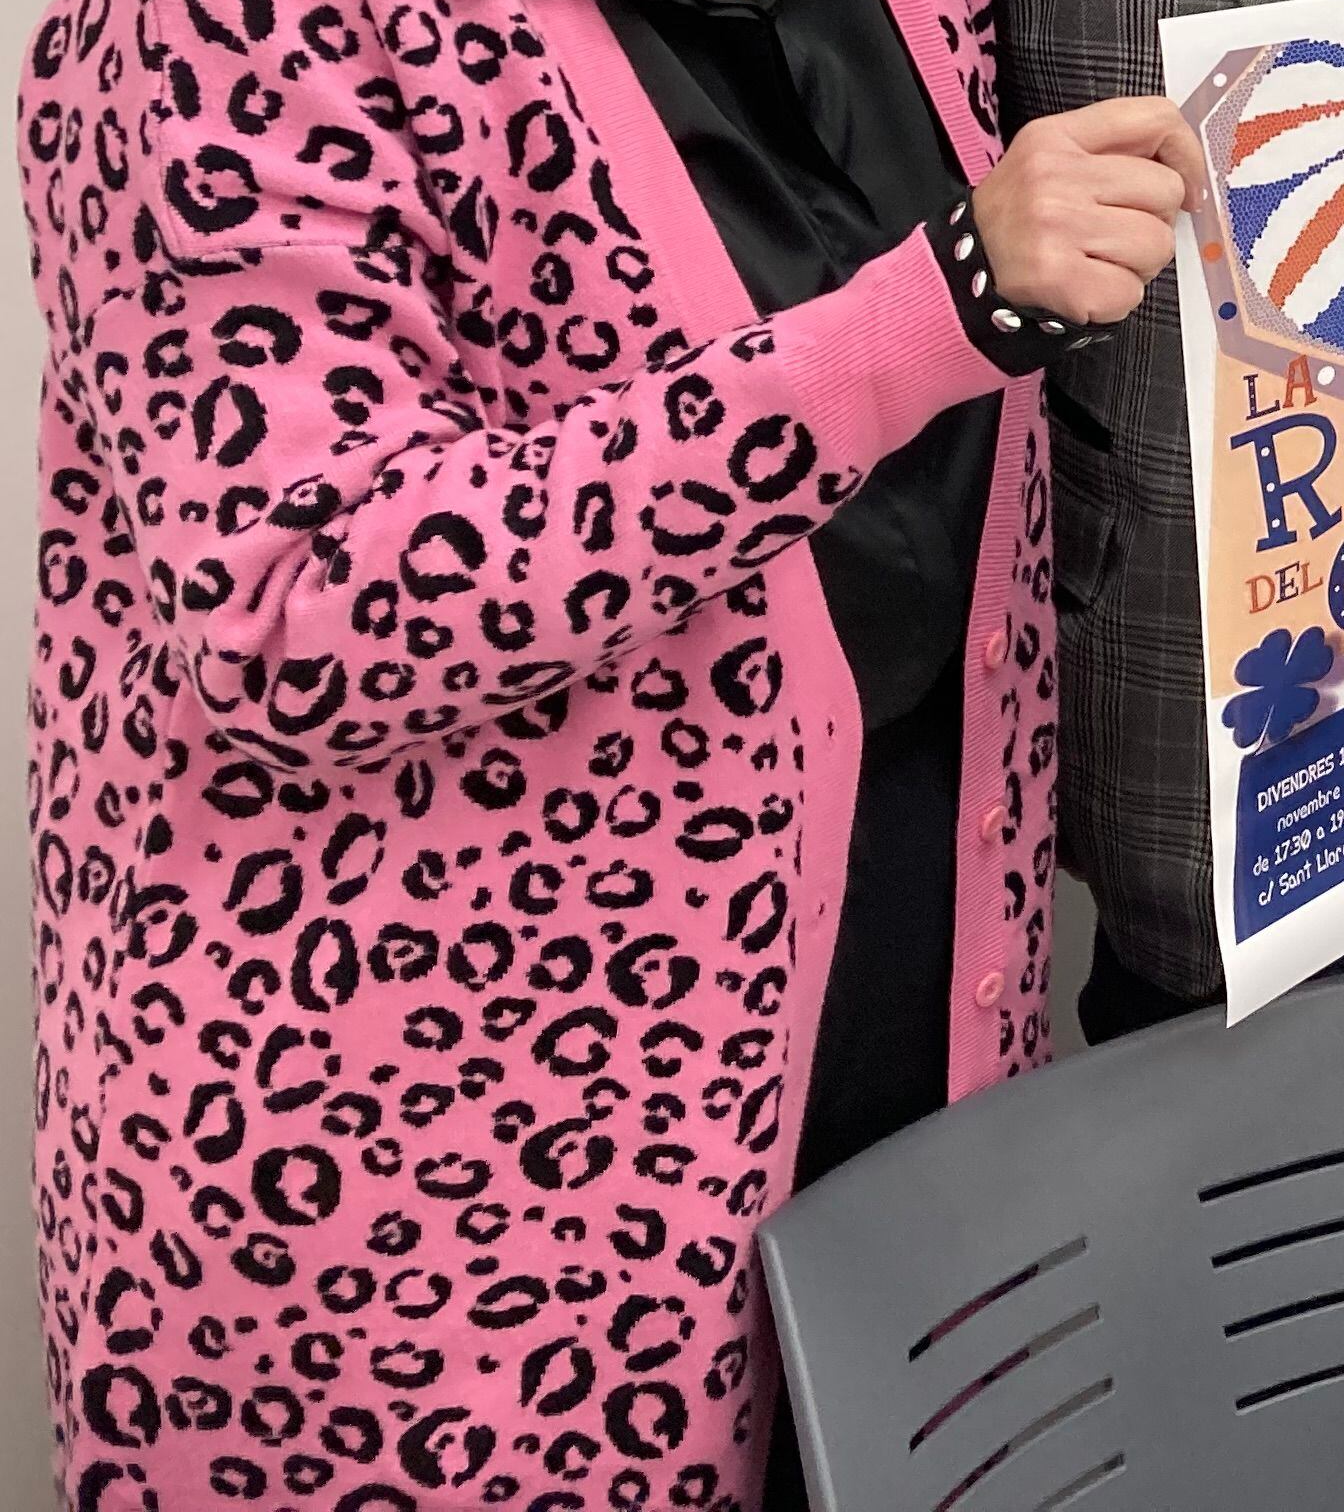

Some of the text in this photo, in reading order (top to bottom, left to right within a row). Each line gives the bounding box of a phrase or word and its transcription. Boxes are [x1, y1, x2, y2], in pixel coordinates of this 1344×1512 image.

[1243, 354, 1318, 421] LA
[1246, 561, 1324, 614] DEL
[1257, 753, 1335, 813] DIVENDRES
[1277, 785, 1341, 832] novembre
[1253, 855, 1270, 876] de
[1316, 826, 1325, 839] a
[1258, 881, 1274, 907] c/
[1278, 860, 1312, 896] Sant
